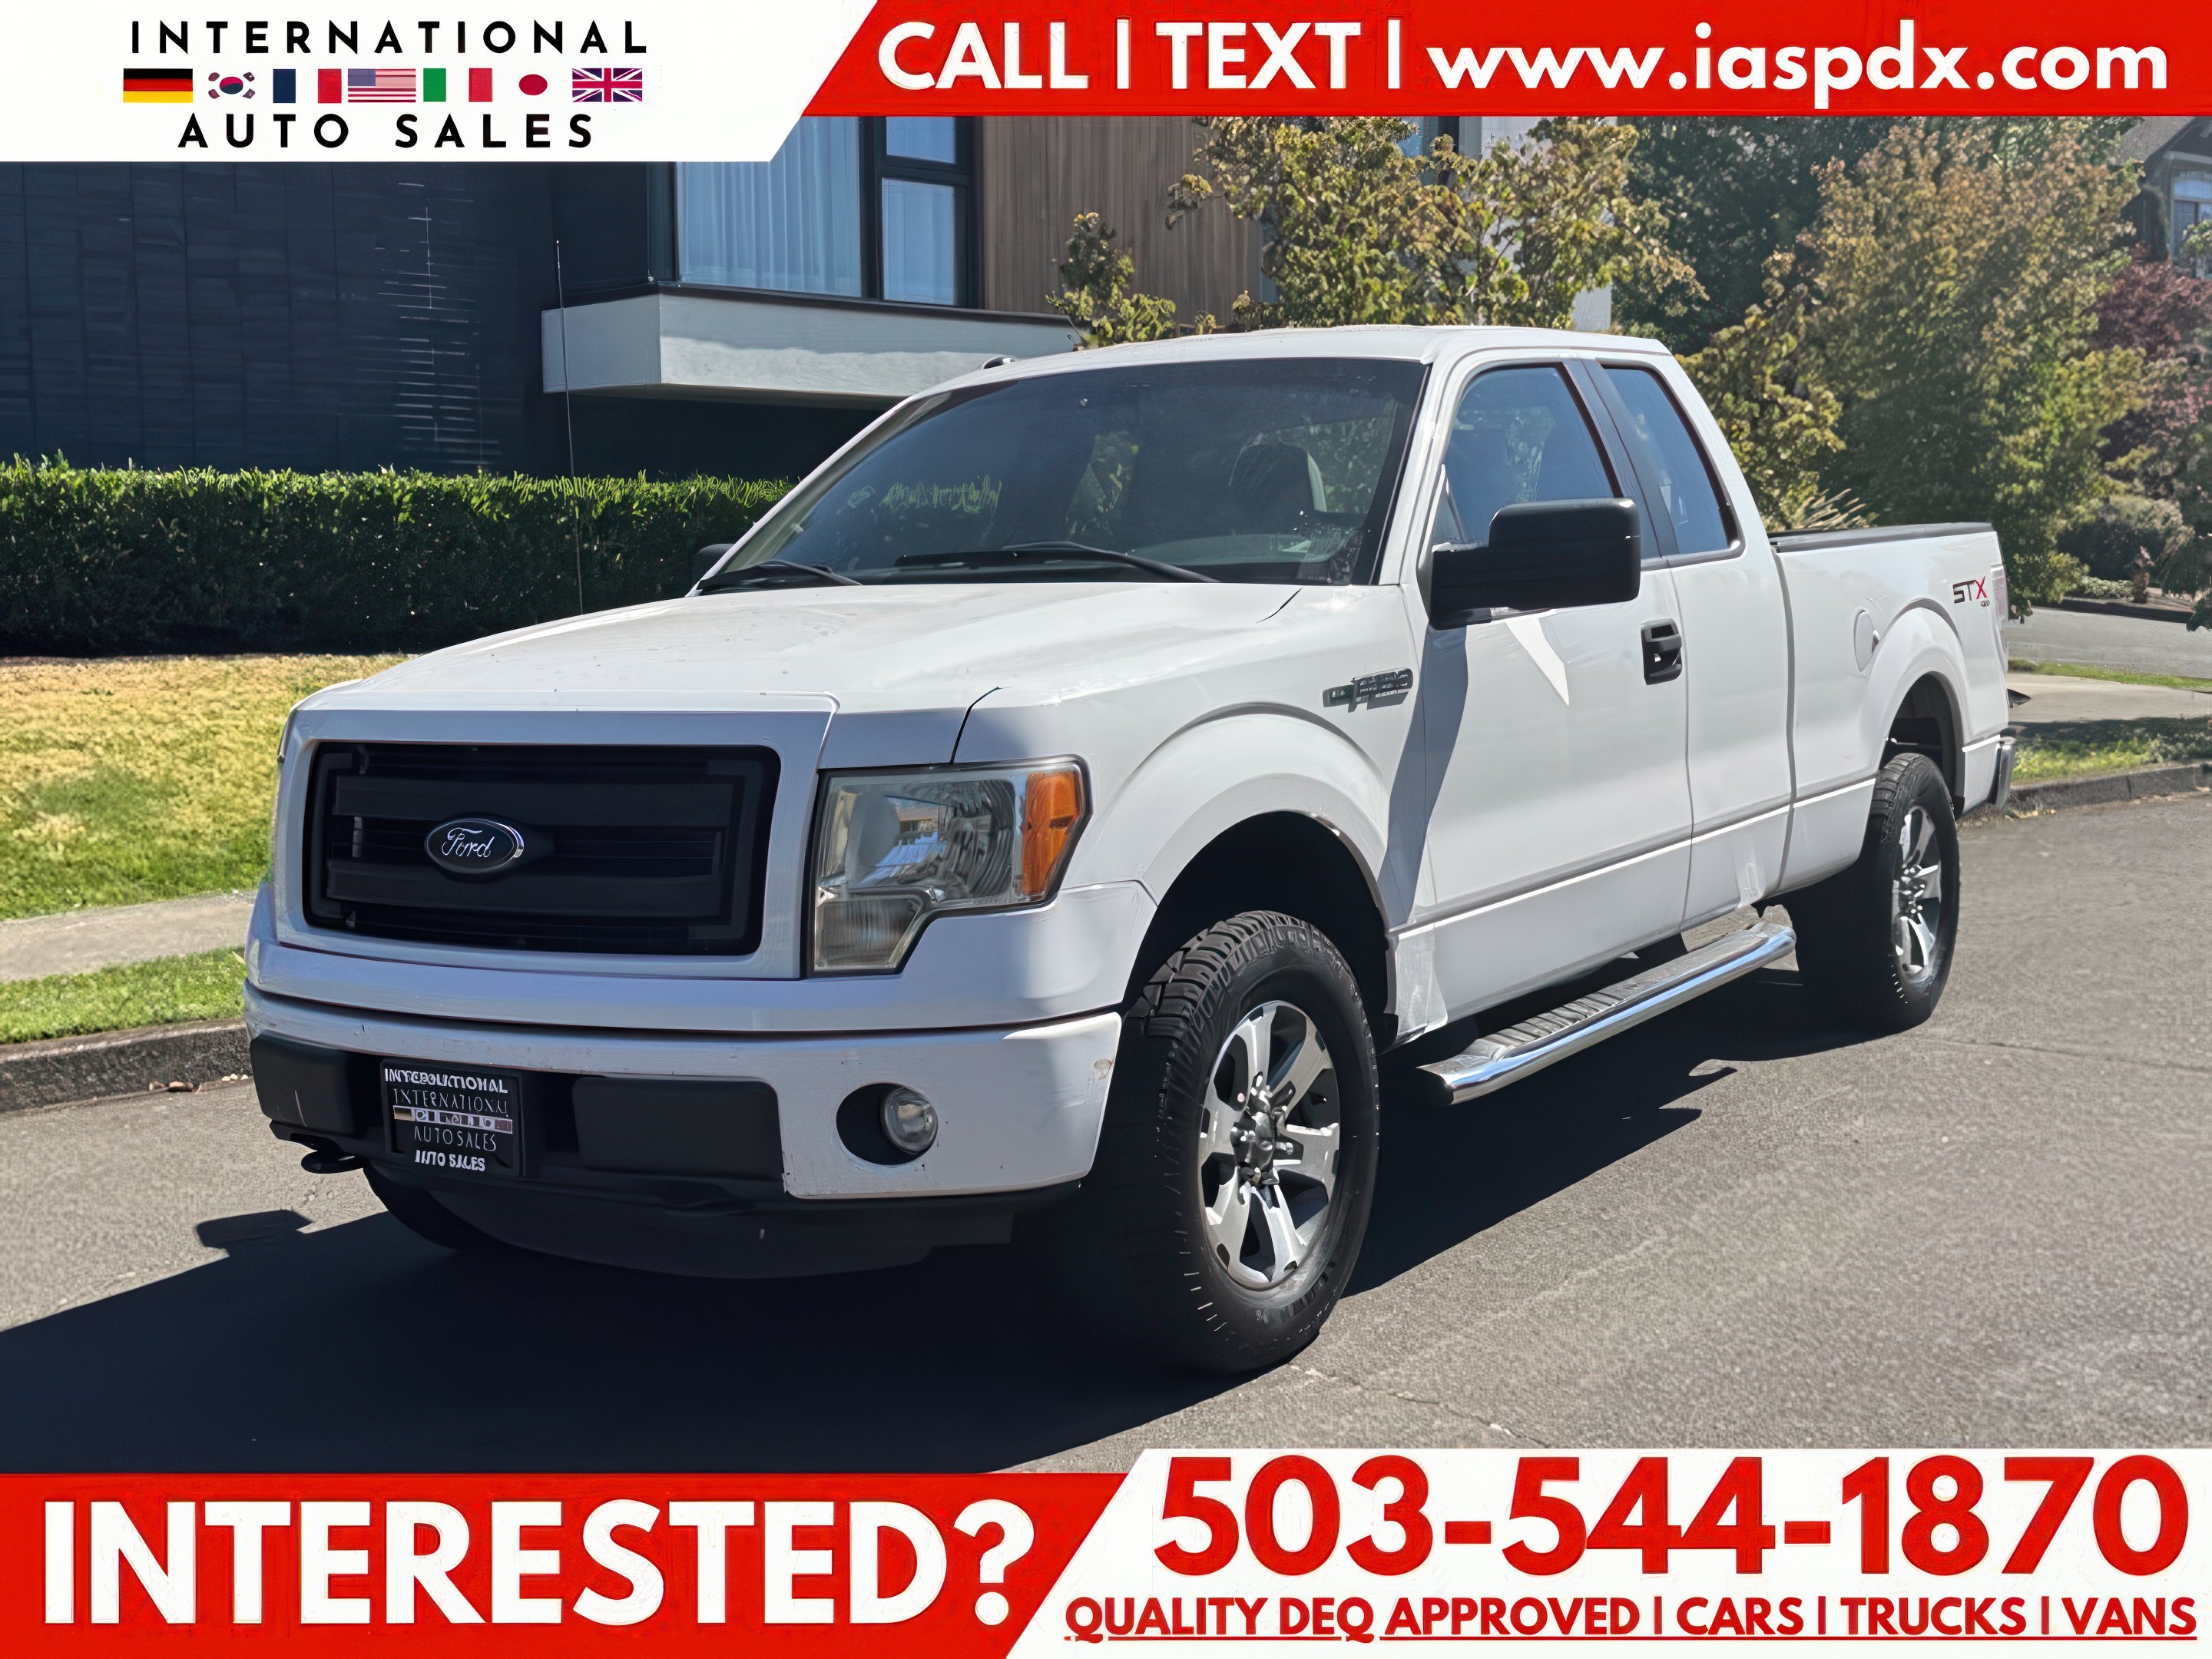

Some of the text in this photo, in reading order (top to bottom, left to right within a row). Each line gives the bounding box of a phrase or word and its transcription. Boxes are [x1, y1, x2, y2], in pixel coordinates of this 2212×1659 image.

[1952, 576, 1988, 604] STX
[442, 827, 495, 858] Ford
[414, 1124, 497, 1151] AUTO SALES
